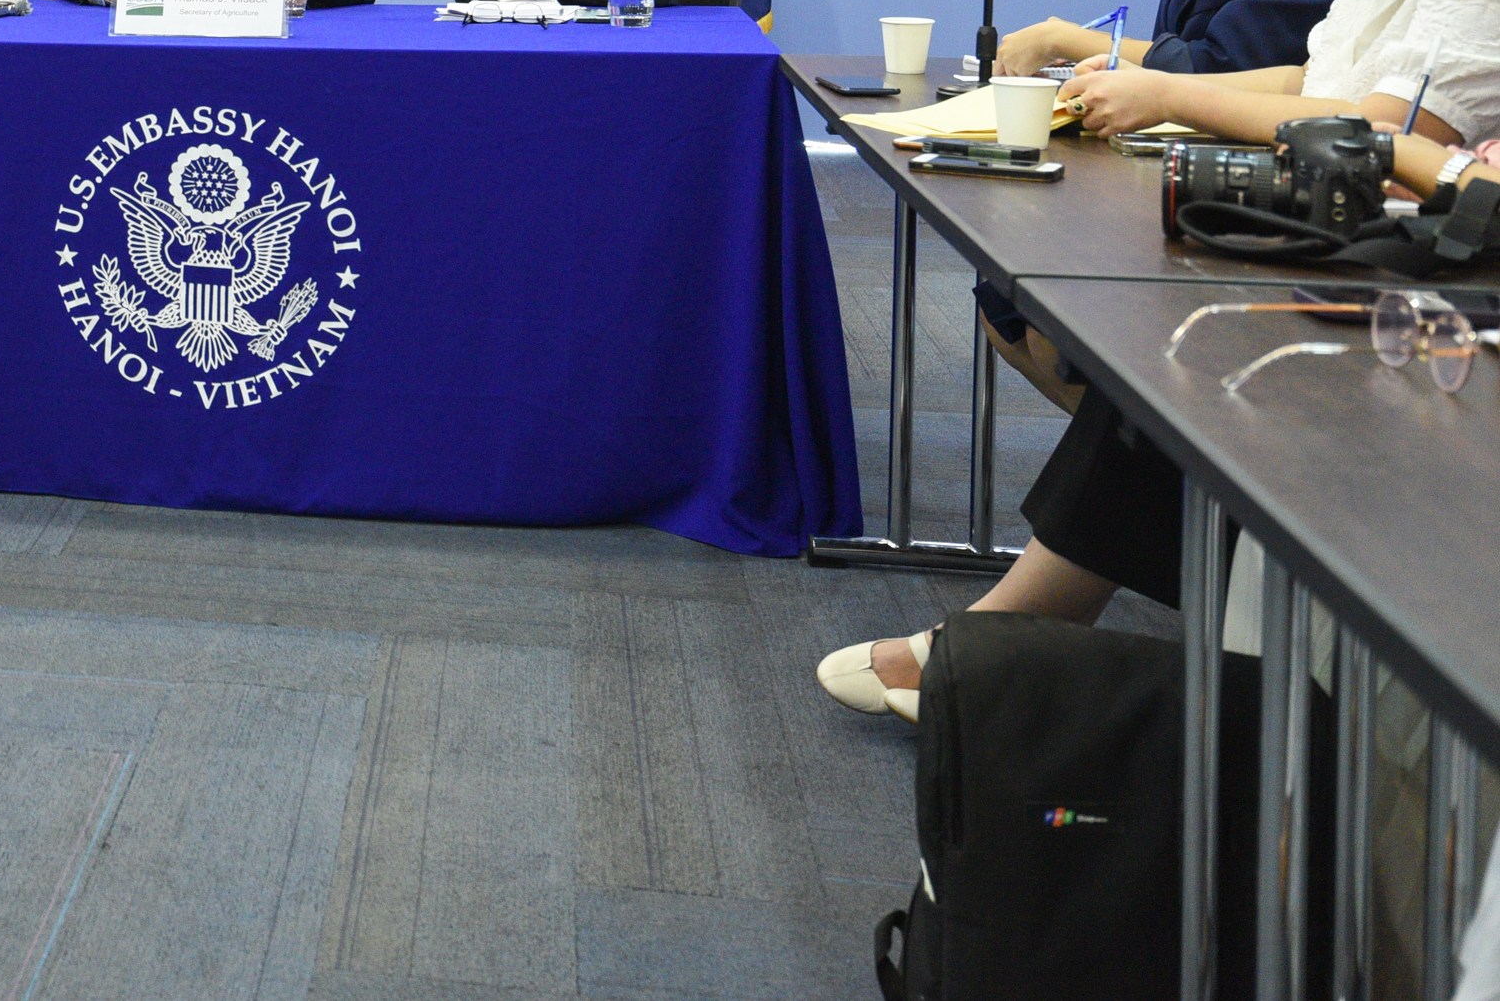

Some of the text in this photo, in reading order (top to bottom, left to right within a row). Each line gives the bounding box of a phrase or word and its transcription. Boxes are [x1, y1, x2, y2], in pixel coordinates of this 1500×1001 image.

[179, 8, 212, 16] Secretary
[222, 9, 259, 17] Agriculture
[235, 208, 262, 226] UNUM
[265, 127, 362, 255] HANOI
[57, 277, 356, 410] HANOI VIETNAM
